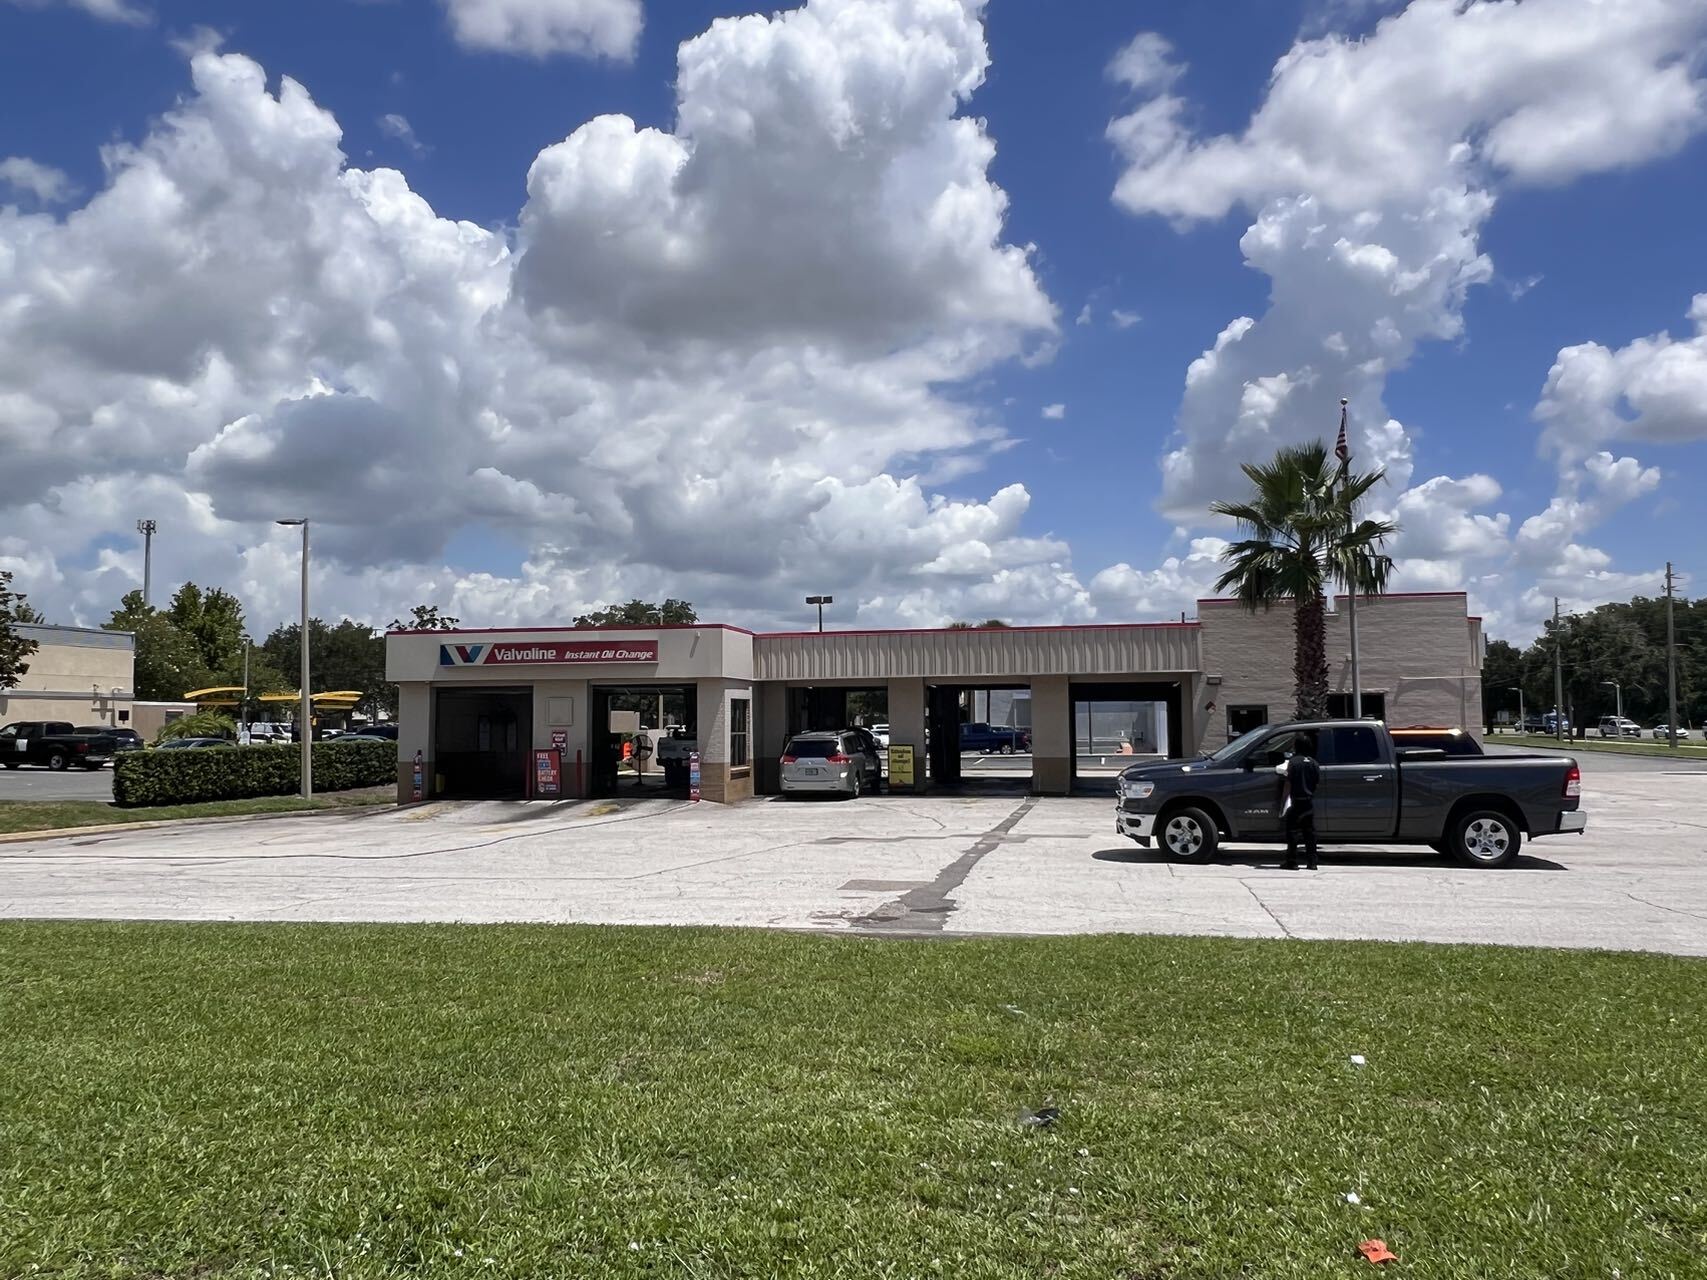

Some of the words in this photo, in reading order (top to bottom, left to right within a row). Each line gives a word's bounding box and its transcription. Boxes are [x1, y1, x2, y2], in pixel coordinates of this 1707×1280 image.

[494, 648, 556, 661] Valvoline
[564, 651, 600, 659] Instant
[601, 650, 615, 659] Oil
[616, 650, 653, 660] Change
